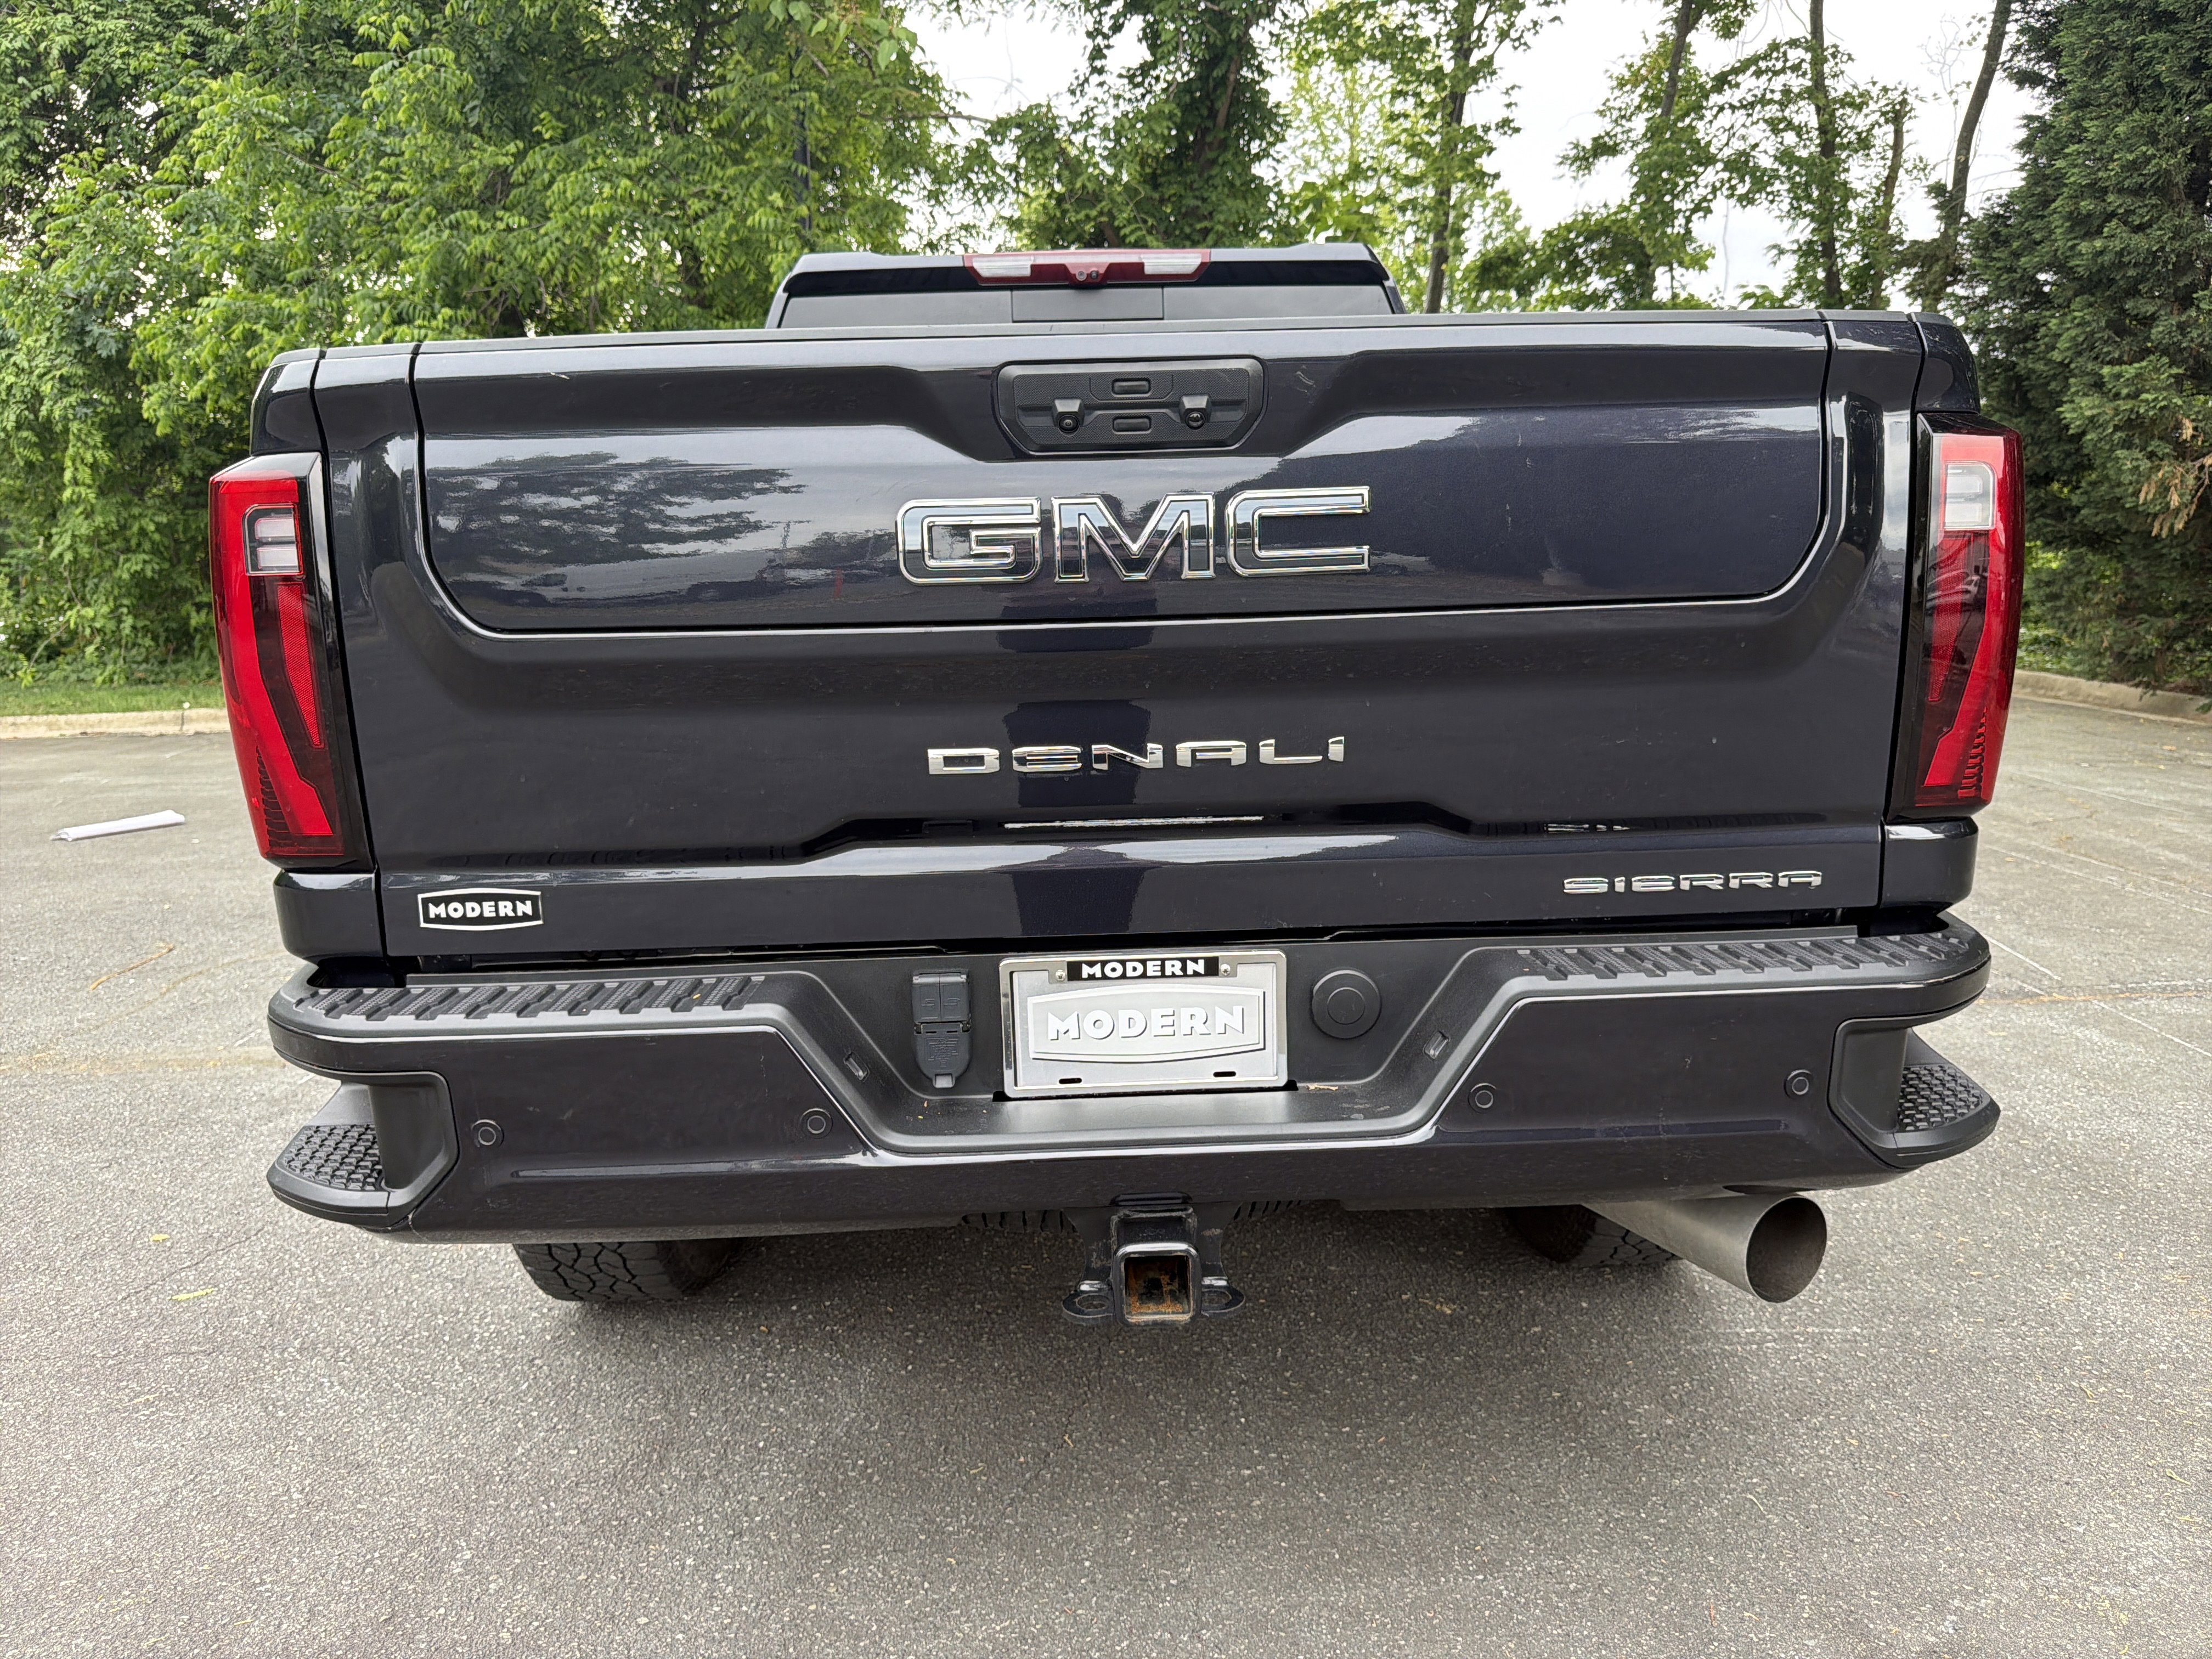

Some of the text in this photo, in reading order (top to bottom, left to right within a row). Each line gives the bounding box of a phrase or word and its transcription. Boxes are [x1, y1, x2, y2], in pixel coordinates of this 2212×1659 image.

[895, 486, 1370, 585] GMC
[928, 736, 1345, 774] DENALI
[1564, 871, 1822, 893] SIERRA
[428, 900, 533, 918] MODERN
[1081, 959, 1205, 978] MODERN
[1048, 1005, 1244, 1040] MODERN
